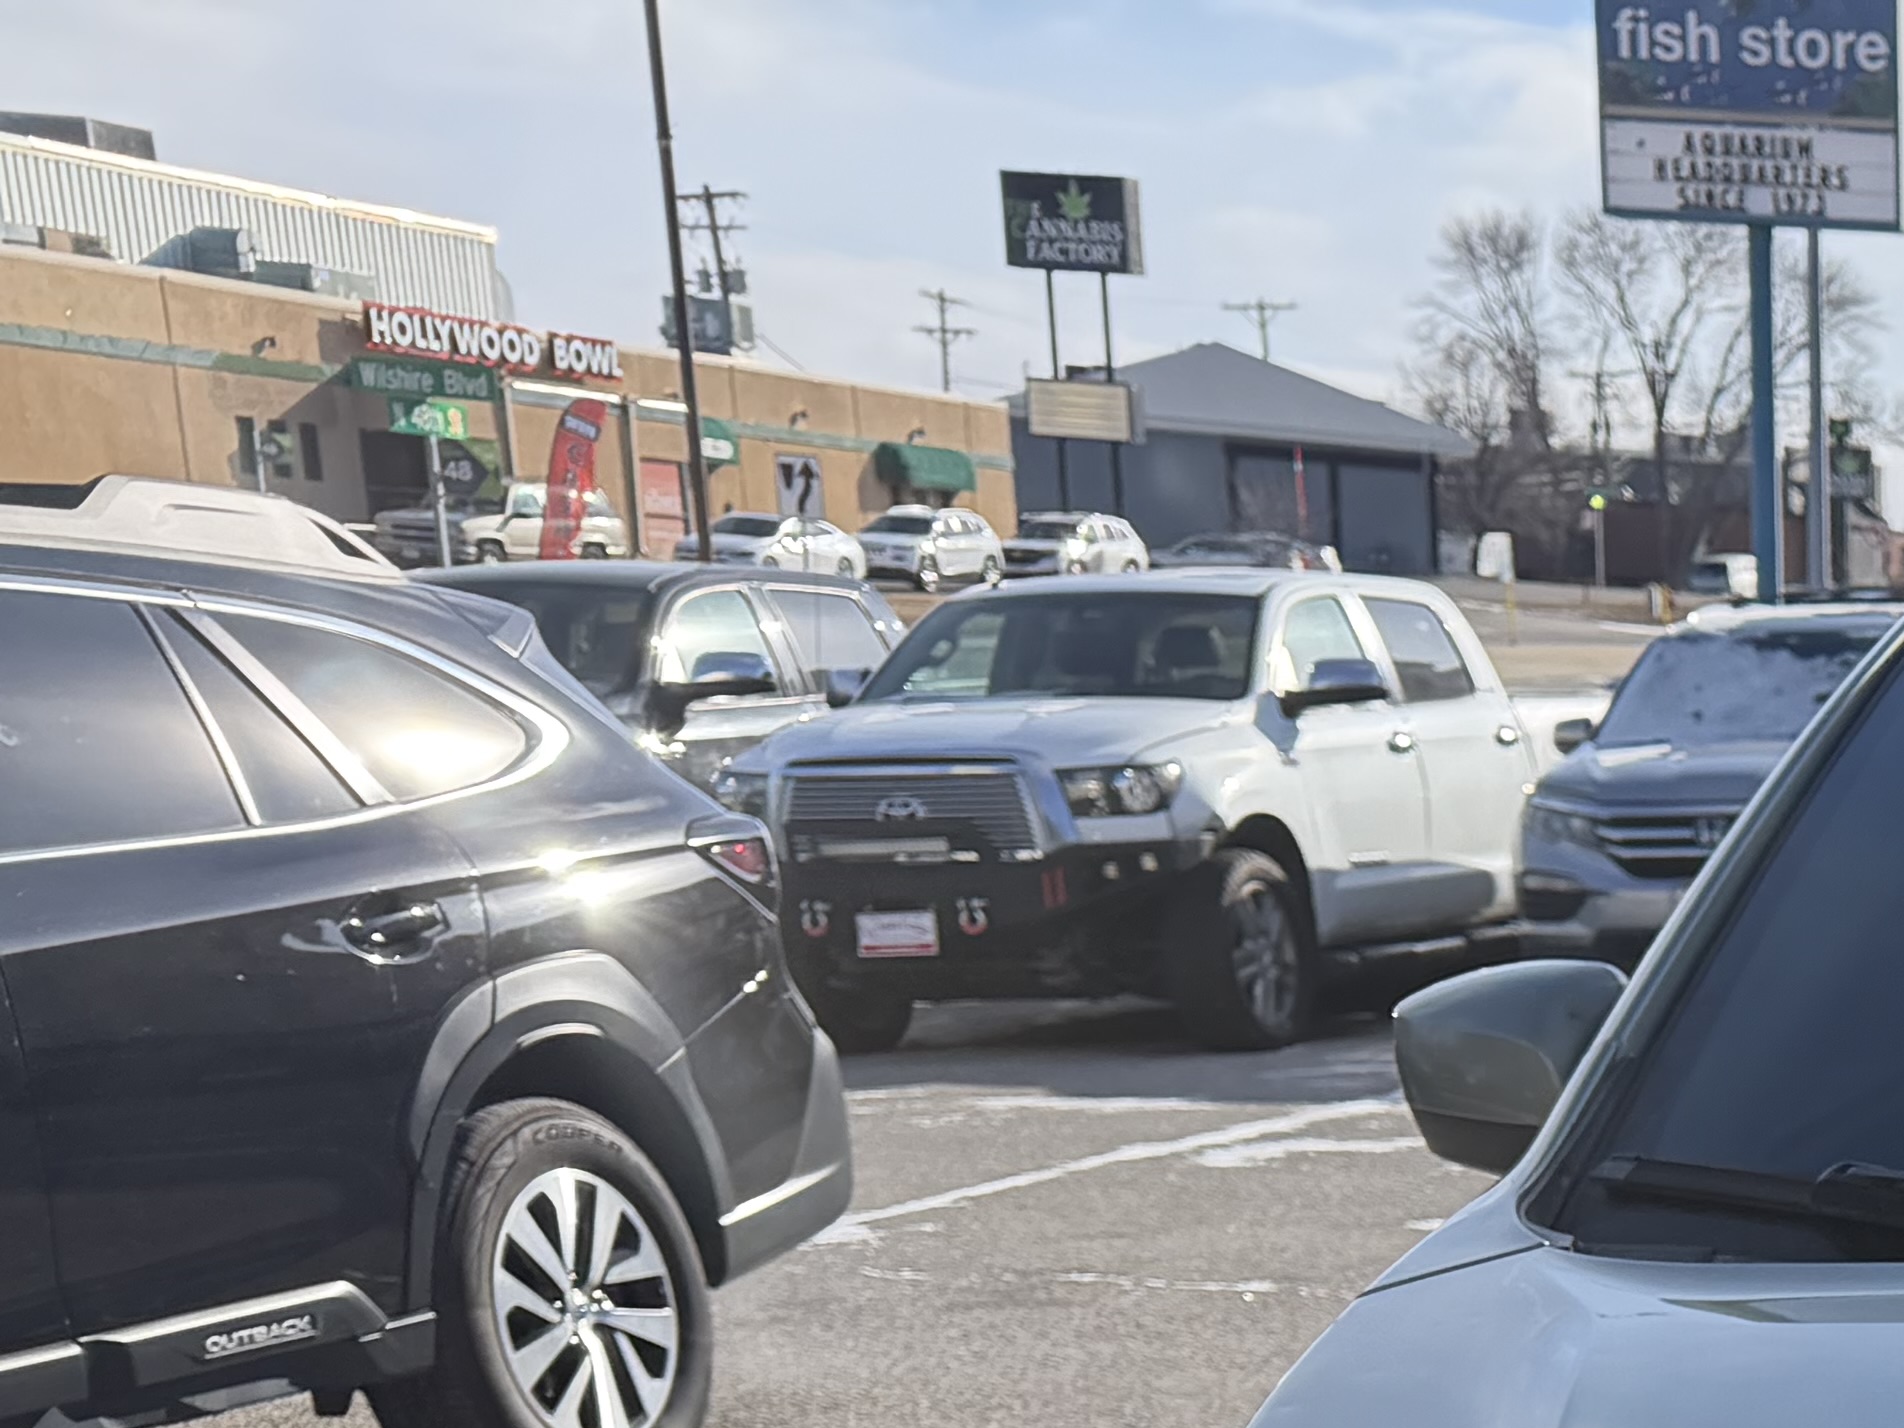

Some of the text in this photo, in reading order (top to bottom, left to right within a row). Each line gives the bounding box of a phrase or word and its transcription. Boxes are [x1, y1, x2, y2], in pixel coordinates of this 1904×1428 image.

[1611, 7, 1891, 73] fish store
[1681, 130, 1814, 159] AQUARIUM
[1653, 157, 1849, 192] HEADQUARTERS
[1676, 185, 1746, 211] SINCE
[1026, 240, 1121, 264] FACTORY
[368, 307, 624, 377] HOLLYWOOD BOWL
[358, 361, 489, 397] Wilshire Blvd
[532, 1123, 622, 1154] COOPER
[205, 1314, 313, 1353] OUTBACK
